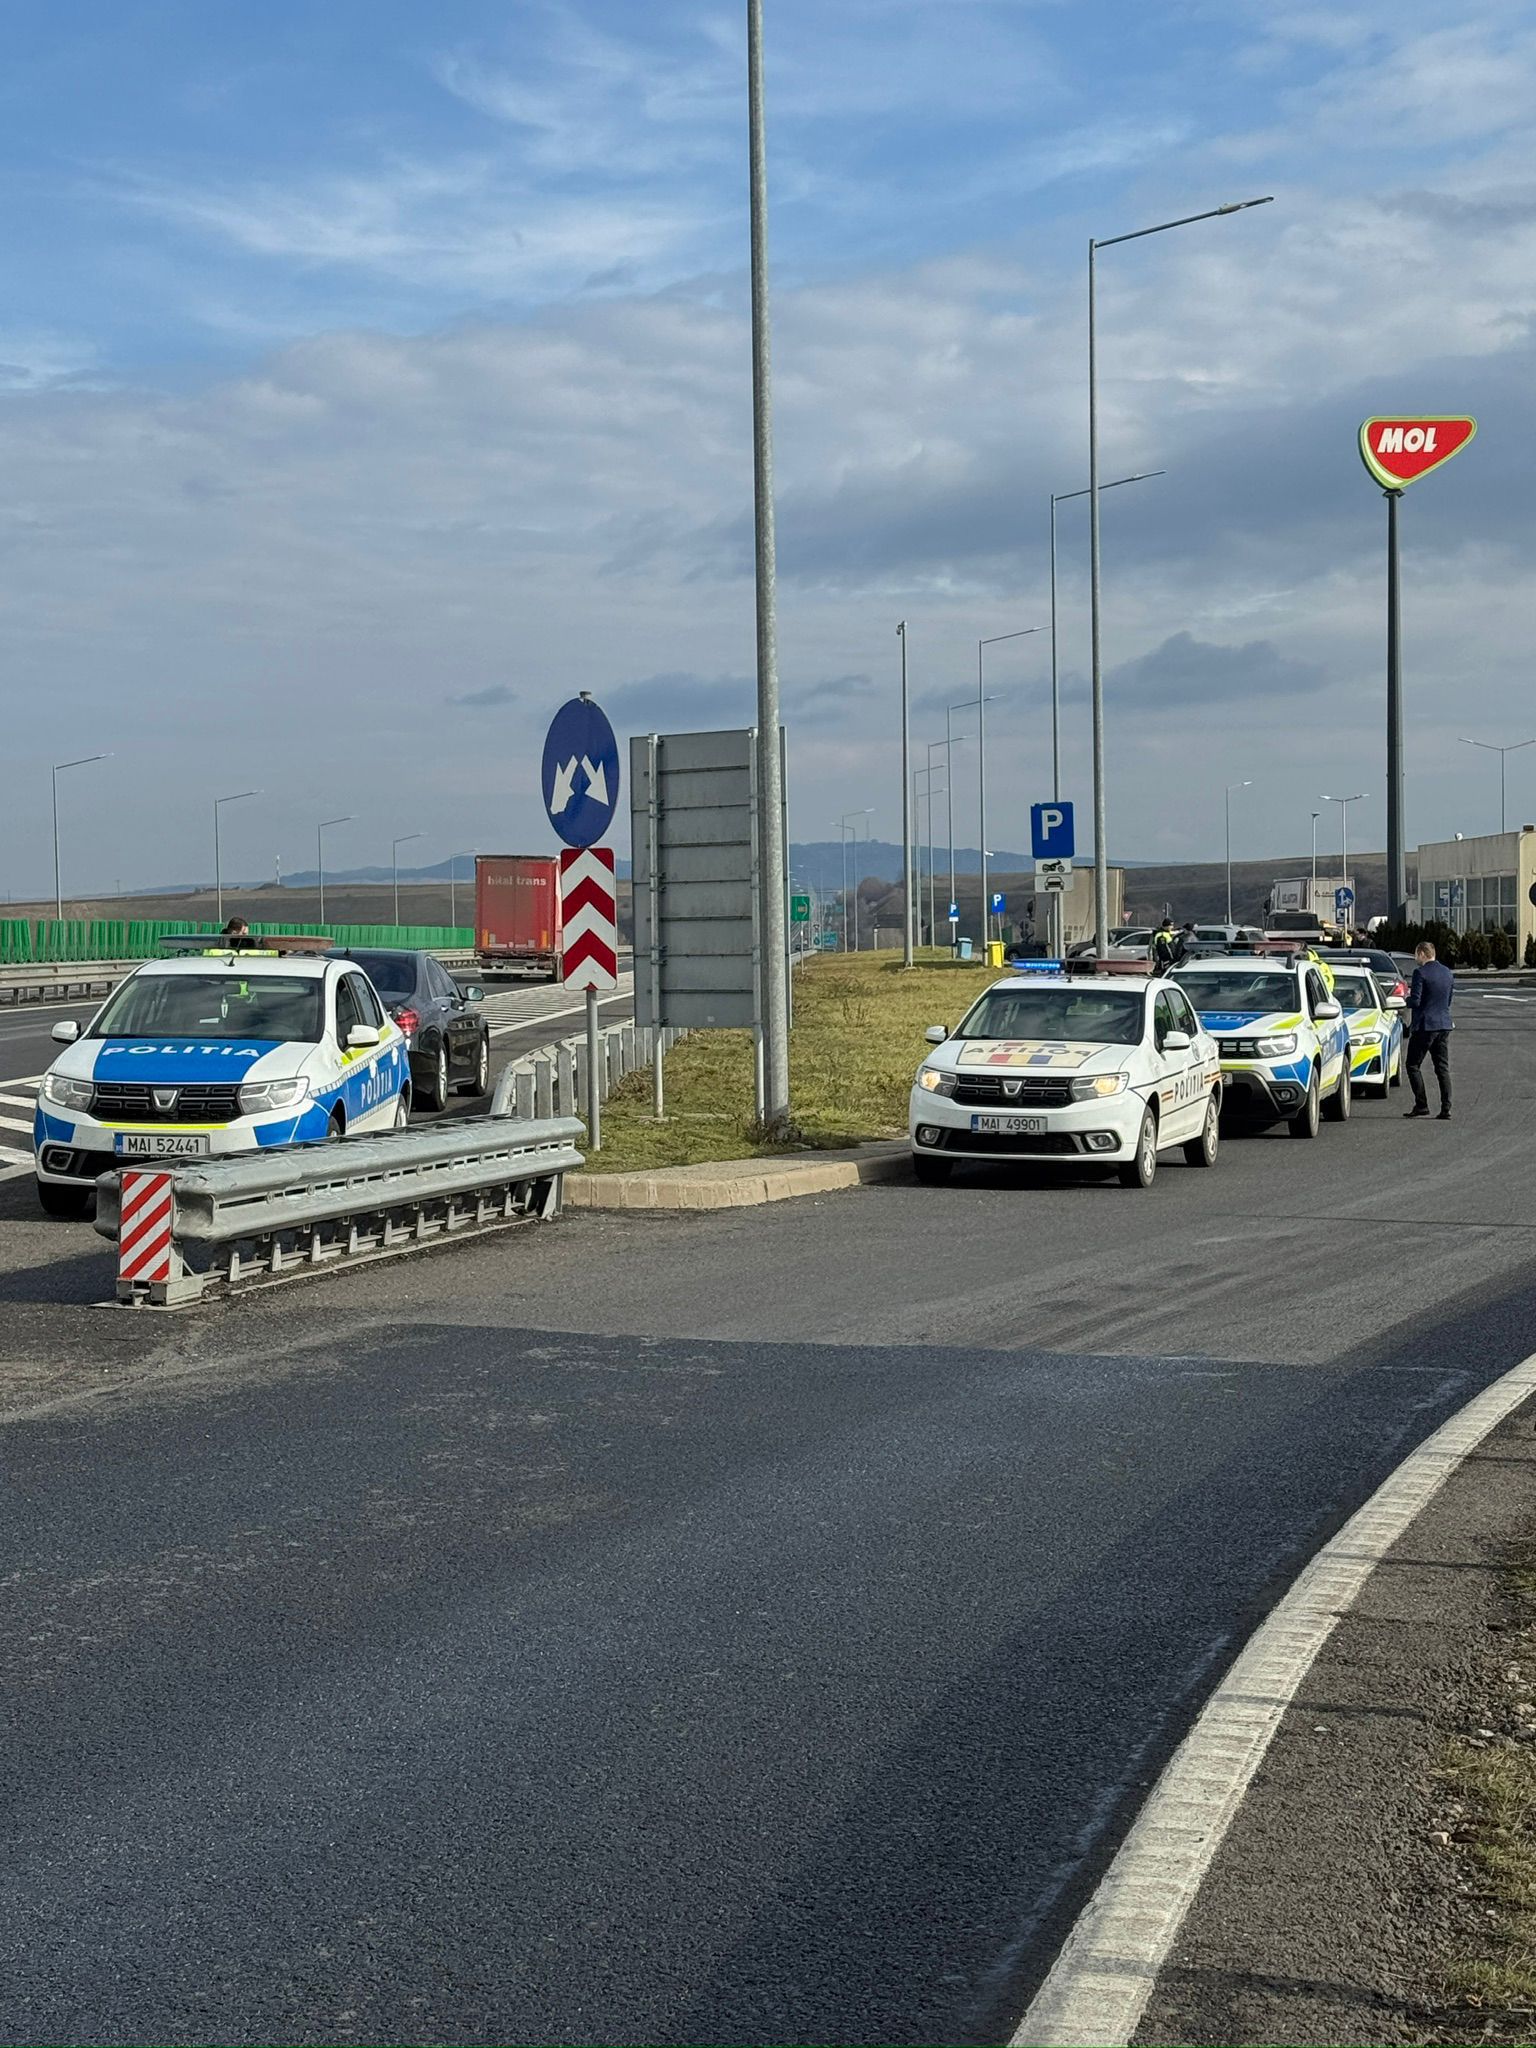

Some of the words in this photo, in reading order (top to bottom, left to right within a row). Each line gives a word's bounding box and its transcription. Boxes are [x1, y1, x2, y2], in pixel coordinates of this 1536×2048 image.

[1377, 427, 1437, 453] MOL
[1041, 809, 1063, 840] P
[516, 875, 547, 887] trans
[993, 894, 1002, 906] P
[102, 1045, 260, 1057] POLITIA
[361, 1068, 393, 1109] POLITIA
[1174, 1072, 1204, 1103] POLITIA
[980, 1117, 1000, 1130] MAI
[1006, 1118, 1041, 1131] 49901
[127, 1136, 151, 1153] MAI
[156, 1137, 200, 1153] 52441
